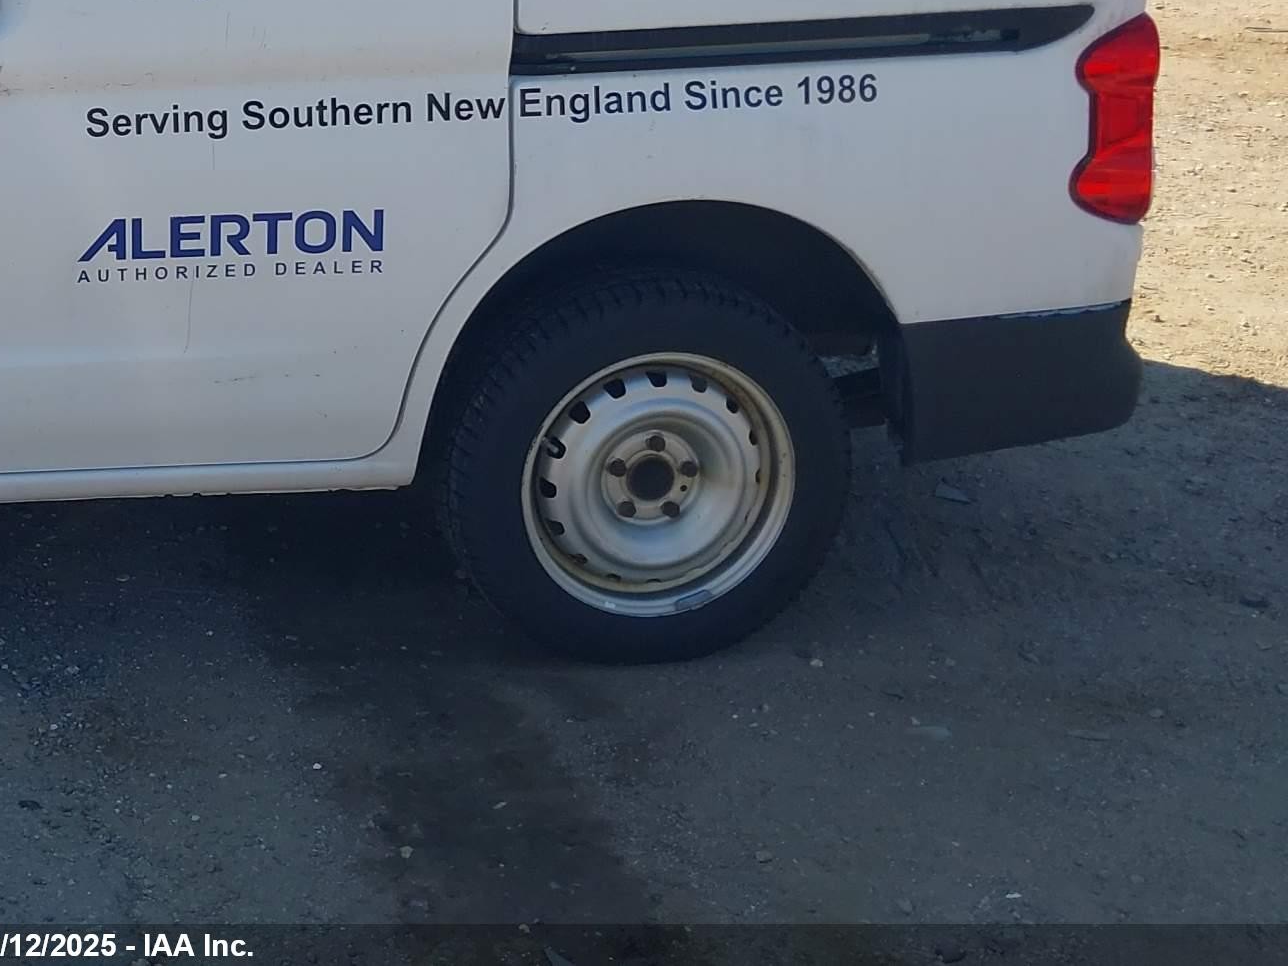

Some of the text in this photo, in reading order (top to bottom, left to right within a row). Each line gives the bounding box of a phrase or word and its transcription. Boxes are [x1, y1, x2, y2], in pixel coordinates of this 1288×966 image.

[87, 74, 877, 139] Serving Southern New England Since 1986
[78, 210, 383, 263] ALERTON
[78, 260, 382, 283] AUTHORIZED DEALER
